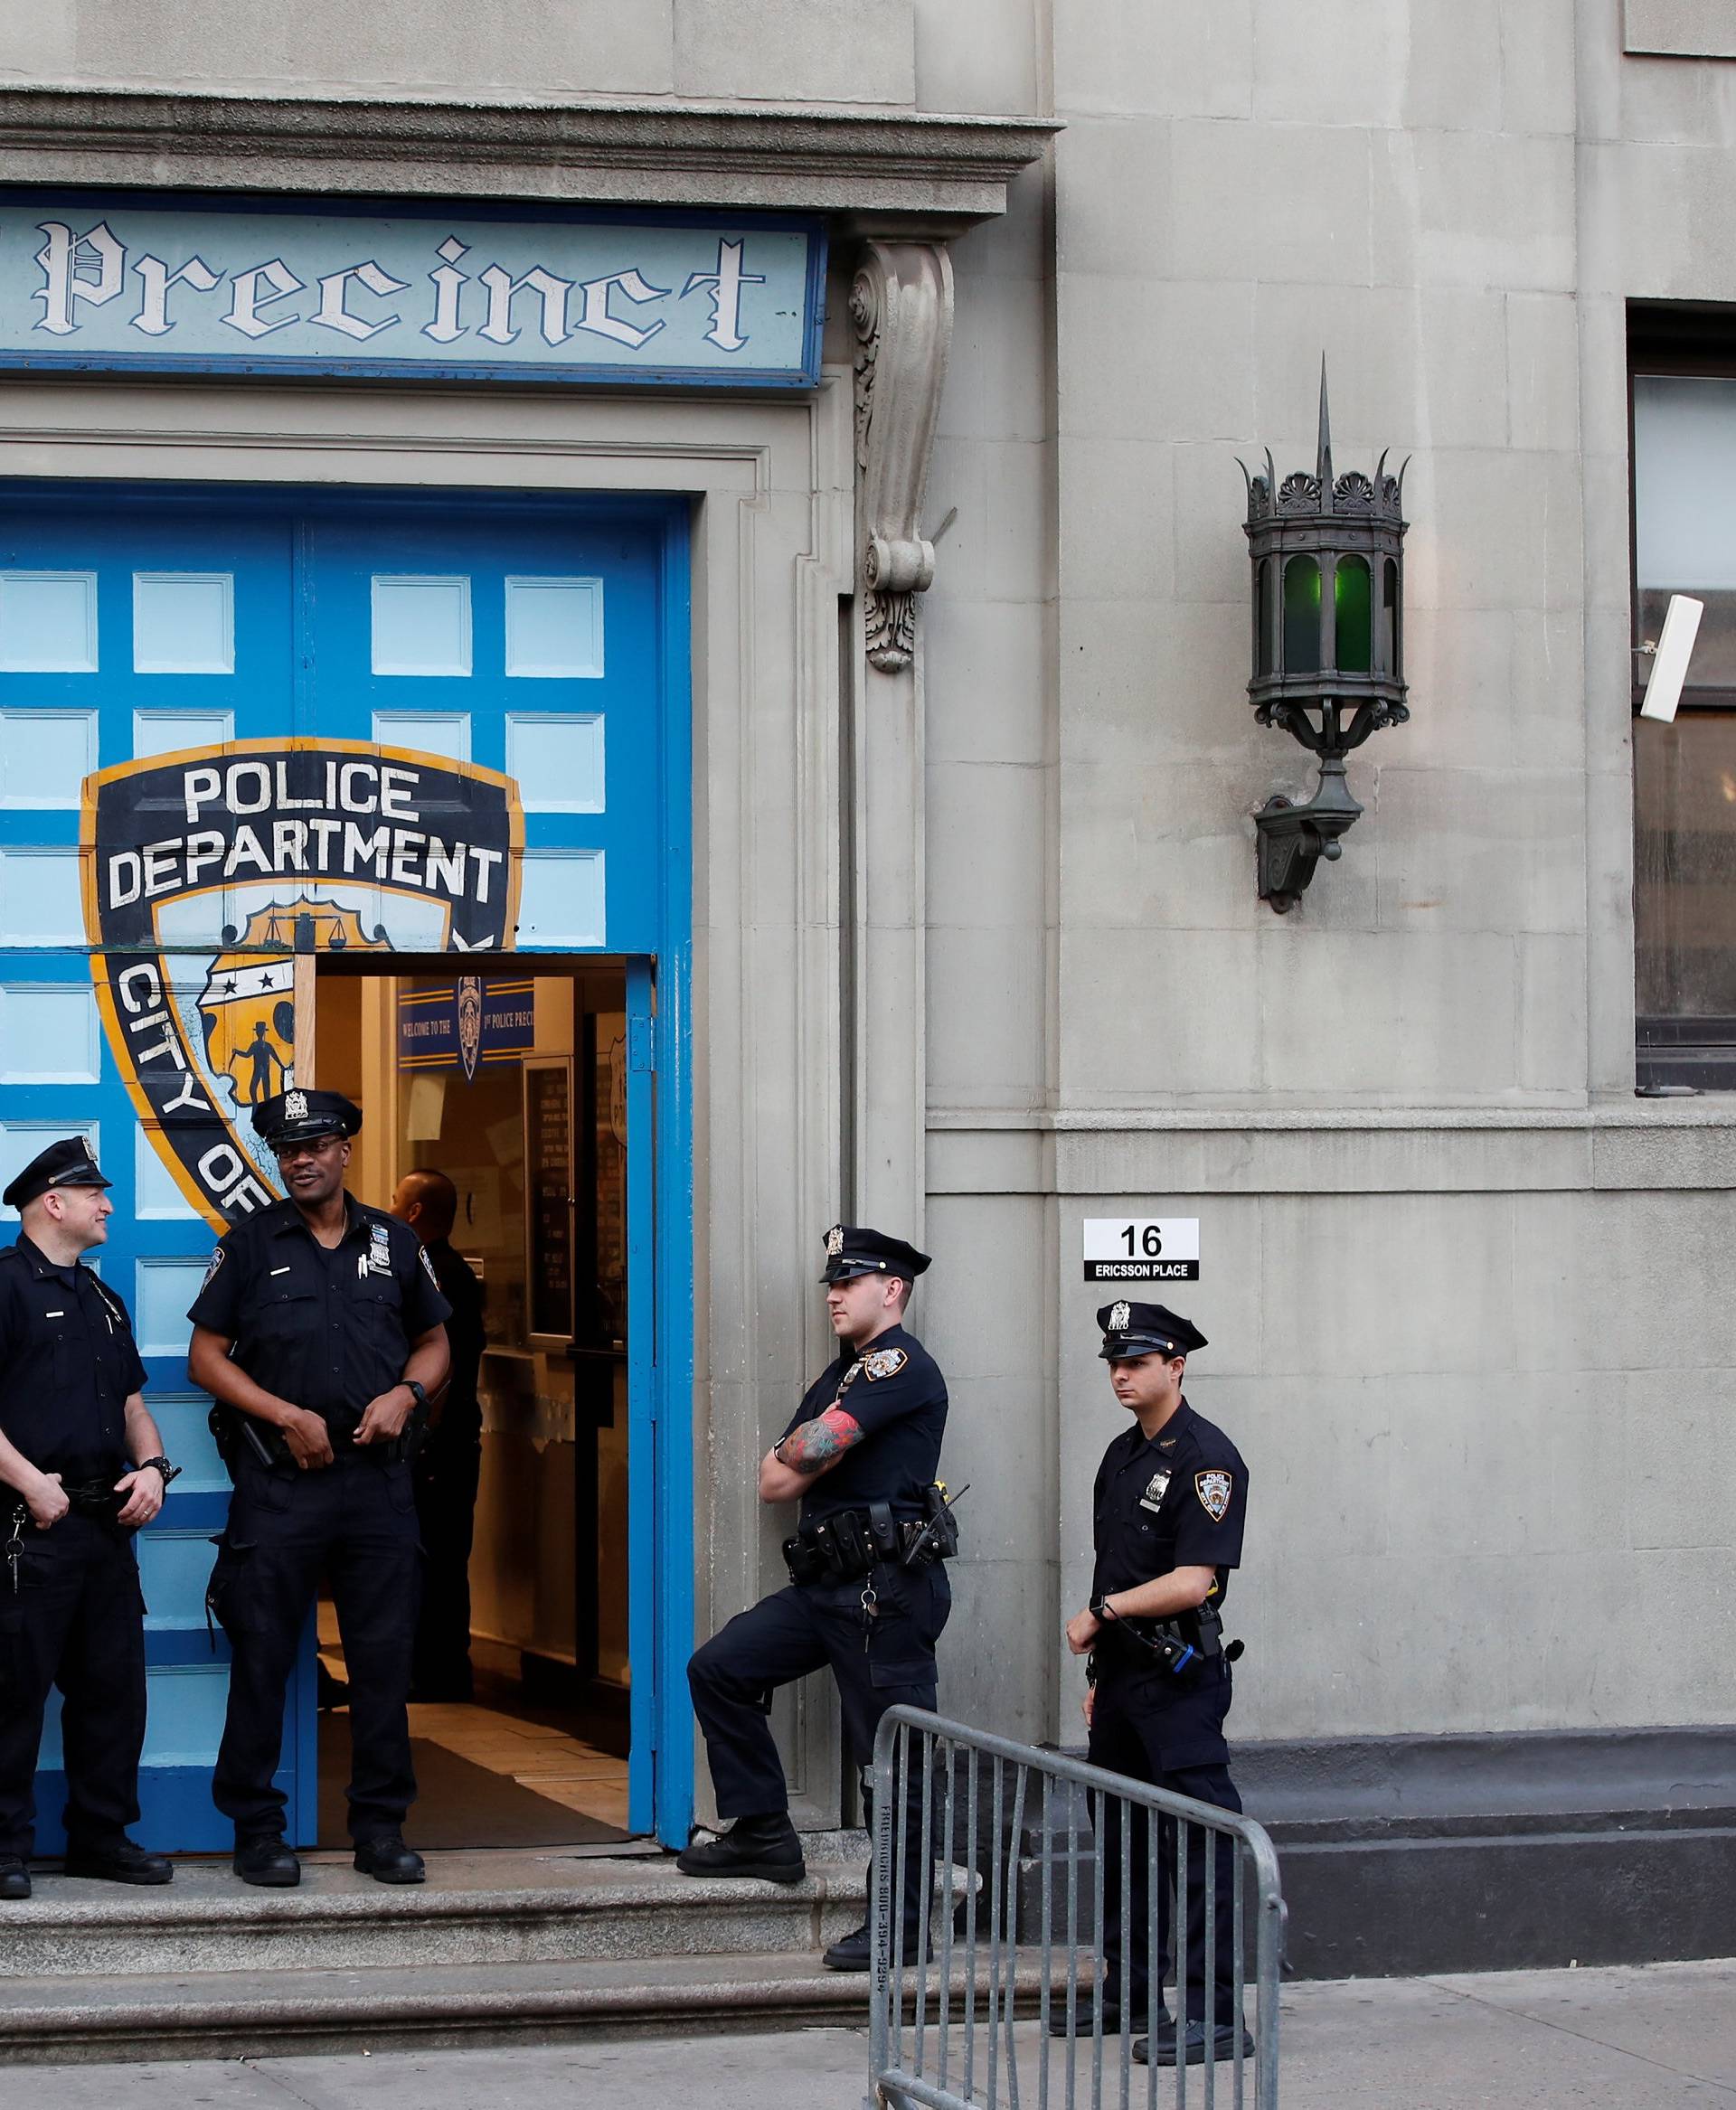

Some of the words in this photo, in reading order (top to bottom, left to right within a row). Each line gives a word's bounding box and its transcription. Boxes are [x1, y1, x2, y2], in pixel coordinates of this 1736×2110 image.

[33, 220, 766, 353] Precinct
[184, 760, 420, 824] POLICE
[109, 819, 503, 909] DEPARTMENT
[402, 1022, 429, 1037] WELCOME
[430, 1021, 439, 1035] TO
[439, 1020, 450, 1034] THE
[492, 1013, 514, 1029] POLICE
[117, 962, 211, 1113] CITY
[197, 1143, 272, 1214] OF
[1095, 1264, 1150, 1276] ERICSSON
[1153, 1264, 1188, 1276] PLACE
[1120, 1225, 1162, 1257] 16
[877, 1887, 891, 1993] 800-394-9294
